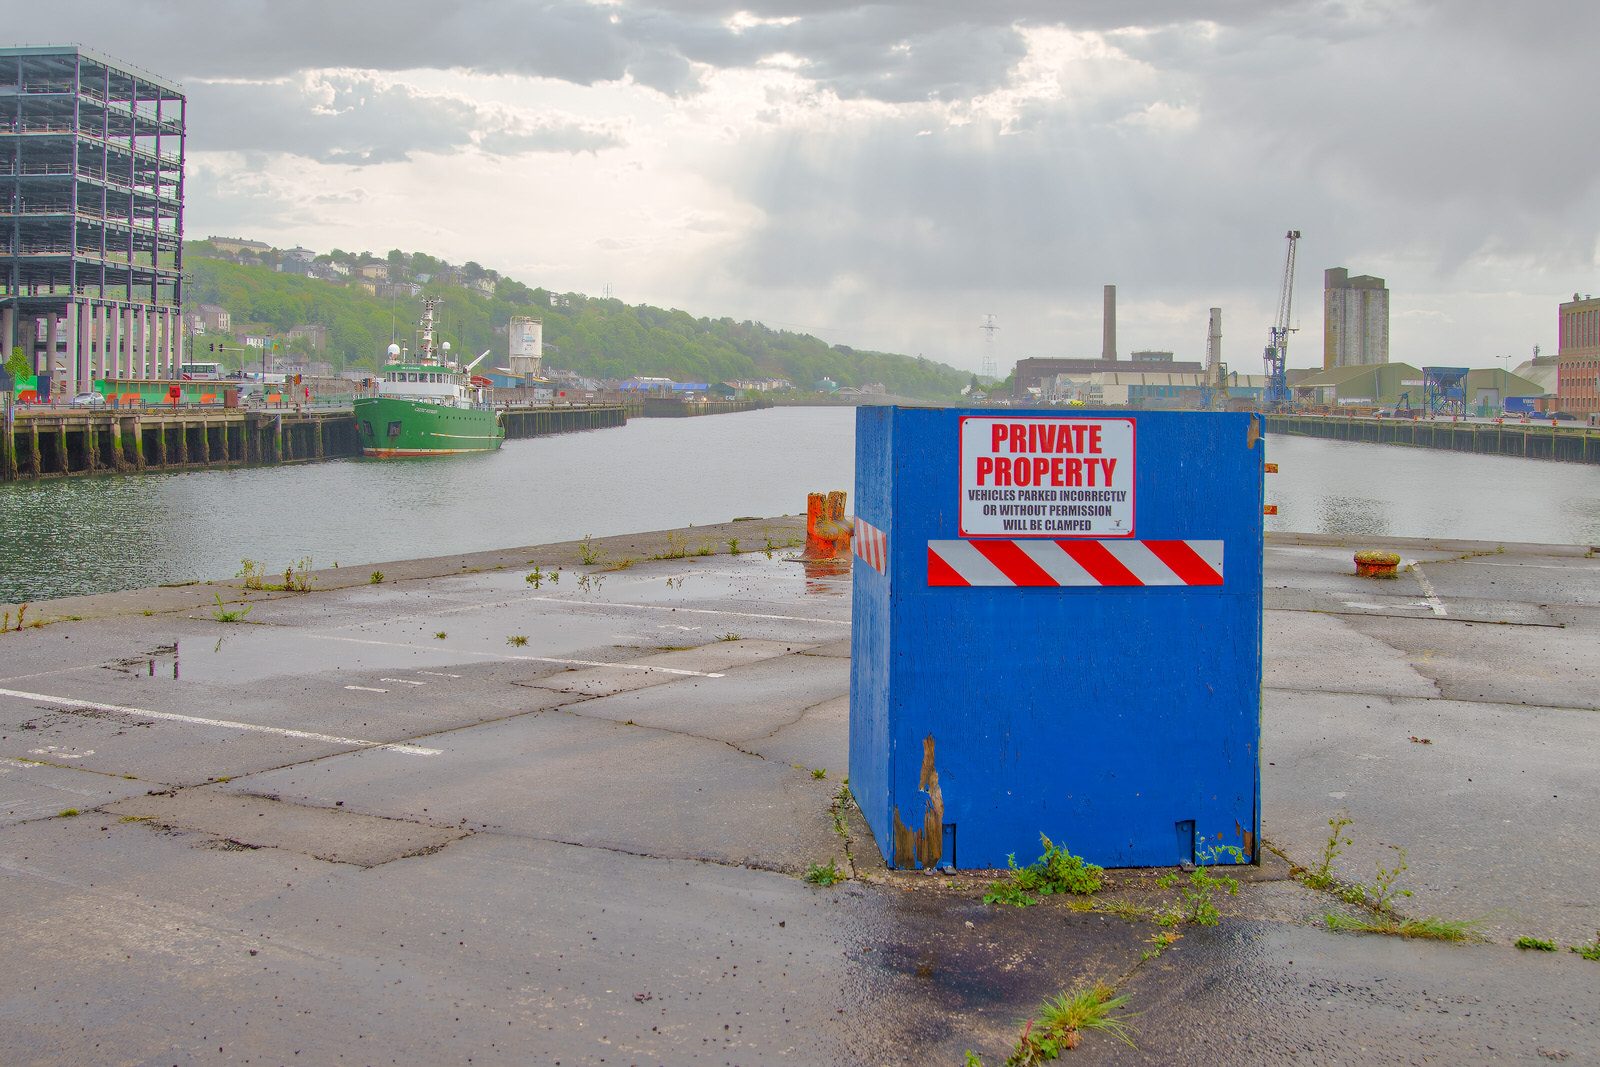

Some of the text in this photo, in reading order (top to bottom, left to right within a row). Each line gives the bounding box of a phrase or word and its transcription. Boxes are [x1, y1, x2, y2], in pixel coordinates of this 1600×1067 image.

[992, 424, 1102, 453] PRIVATE
[977, 457, 1117, 486] PROPERTY
[968, 490, 1126, 502] VEHICLES PARKED INCORRECTLY
[983, 504, 1112, 516] OR WITHOUT PERMISSION
[1004, 519, 1092, 531] WILL BE CLAMPED
